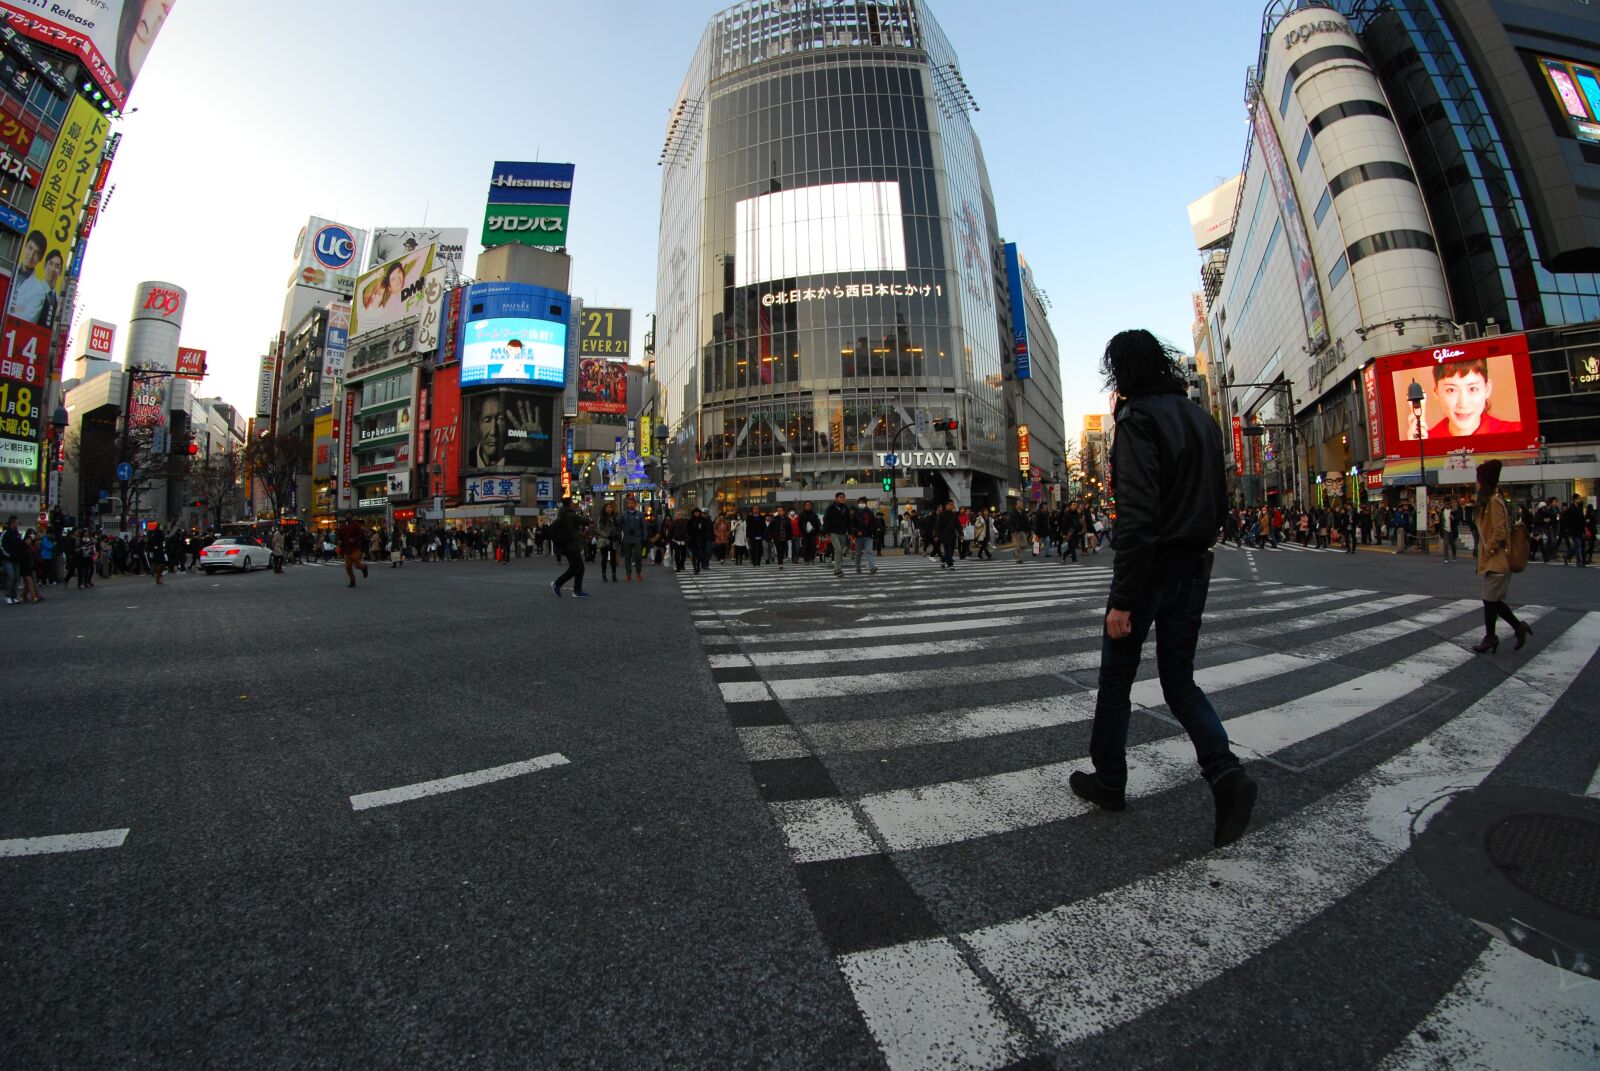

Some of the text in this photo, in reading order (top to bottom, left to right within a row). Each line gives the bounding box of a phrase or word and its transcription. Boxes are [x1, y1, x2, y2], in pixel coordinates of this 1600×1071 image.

[50, 4, 96, 29] Release
[41, 121, 82, 213] 最強の名医
[491, 174, 571, 189] Hisamitsu
[488, 216, 563, 231] サロンパス
[318, 233, 352, 260] UC
[338, 279, 354, 288] VISA
[143, 290, 180, 317] 109
[581, 311, 614, 337] 21
[93, 329, 110, 340] UNI
[92, 338, 109, 350] QLO
[582, 340, 628, 353] EVER 21
[182, 352, 202, 365] H&M
[361, 425, 396, 440] Euphoria
[8, 457, 25, 465] asahi
[469, 480, 550, 496] 大盛堂店
